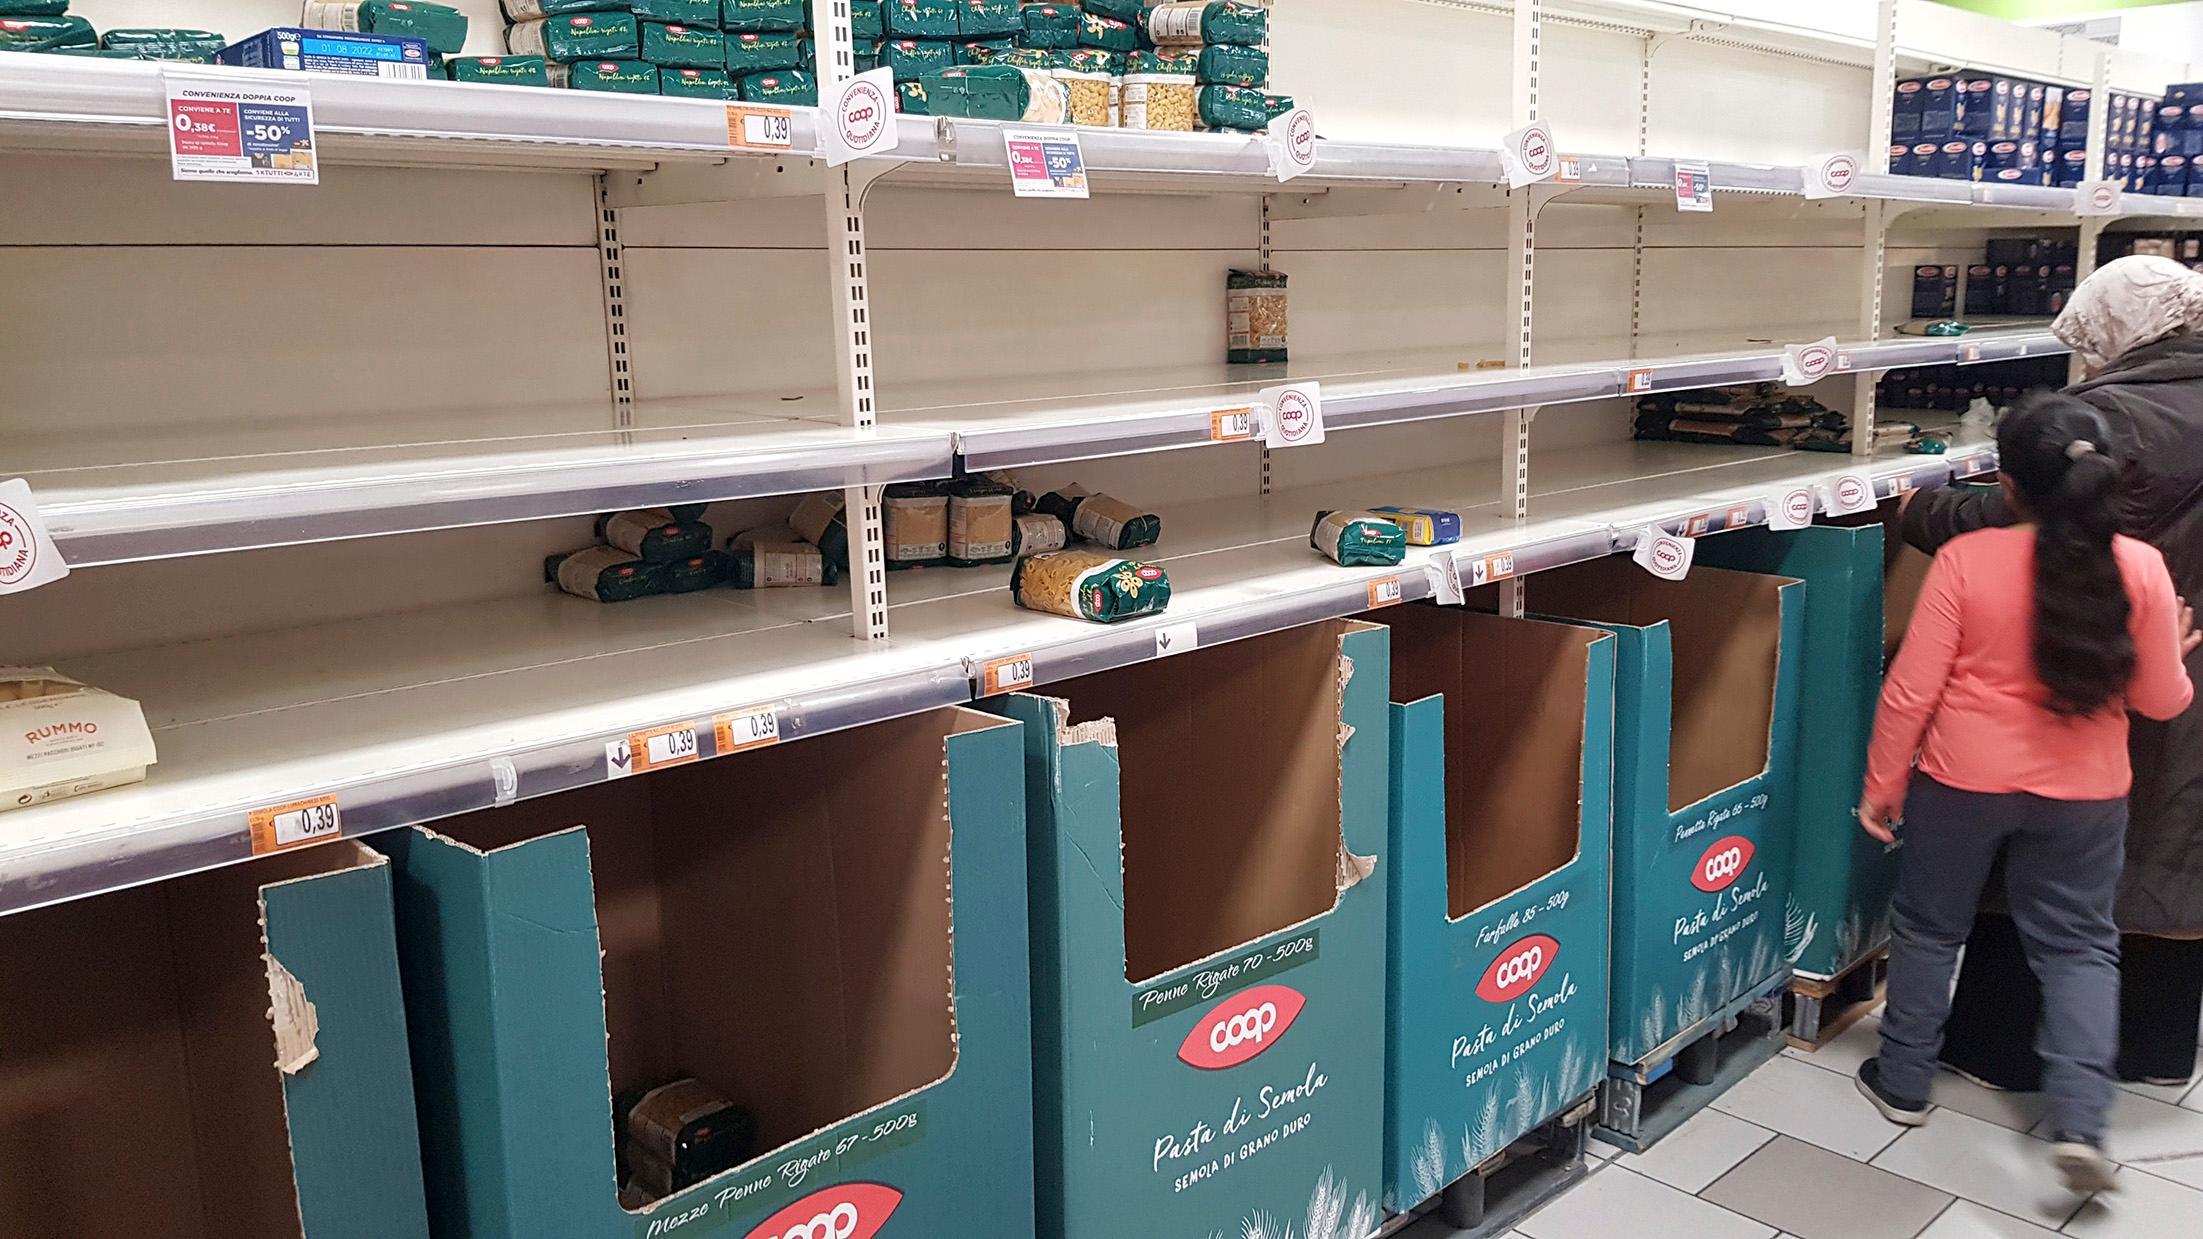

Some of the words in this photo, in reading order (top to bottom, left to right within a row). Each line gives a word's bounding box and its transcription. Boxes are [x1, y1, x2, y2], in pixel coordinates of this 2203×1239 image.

[321, 44, 331, 52] 01
[352, 47, 373, 55] 2022
[182, 90, 240, 99] CONVENIENZA
[243, 93, 272, 101] DOPPIA
[842, 86, 880, 113] CONVENIENZA
[175, 113, 216, 133] 0,38€
[849, 106, 874, 123] coop
[246, 124, 291, 142] -50%
[764, 116, 788, 142] 0,39
[845, 121, 881, 145] QUOTIDIANA
[1529, 145, 1545, 158] coop
[1278, 393, 1308, 411] CONVENIENZA
[1233, 413, 1248, 433] 0,39
[1282, 410, 1303, 421] coop
[1280, 421, 1309, 439] QUOTIDIANA
[1656, 550, 1676, 562] coop
[1386, 580, 1400, 598] 0,39
[1012, 660, 1030, 681] 0,39
[25, 722, 97, 744] RUMMO
[751, 713, 775, 738] 0,39
[668, 729, 694, 756] 0,39
[302, 804, 334, 834] 0,39
[1707, 809, 1731, 830] Rigate
[1705, 847, 1741, 882] coop
[1475, 911, 1520, 948] Farfalle
[1522, 904, 1537, 923] 85
[1546, 889, 1570, 911] 500g
[1674, 908, 1709, 945] Pasta
[1712, 893, 1728, 922] di
[1731, 871, 1769, 912] Semola
[1683, 941, 1709, 962] SEMOLA
[1709, 935, 1719, 947] DI
[1718, 921, 1742, 942] GRANO
[1139, 983, 1188, 1011] Penne
[1192, 964, 1240, 999] Rigate
[1242, 954, 1264, 973] 70
[1272, 937, 1313, 962] 500g
[1497, 945, 1542, 989] coop
[1209, 1002, 1277, 1053] coop
[1451, 1023, 1498, 1069] Pasta
[1502, 1003, 1524, 1036] di
[1527, 972, 1578, 1023] Semola
[1465, 1059, 1499, 1088] SEMOLA
[1501, 1053, 1511, 1066] DI
[1513, 1033, 1543, 1060] GRANO
[1544, 1017, 1566, 1041] DURO
[1153, 1120, 1217, 1173] Pasta
[1223, 1097, 1251, 1135] di
[1258, 1062, 1329, 1119] Semola
[1174, 1160, 1220, 1193] SEMOLA
[1223, 1152, 1235, 1170] DI
[1239, 1129, 1279, 1161] GRANO
[1282, 1112, 1312, 1138] DURO
[646, 1203, 710, 1239] Mezze
[714, 1175, 773, 1209] Penne
[776, 1149, 832, 1188] Rigate
[834, 1134, 860, 1156] 67
[867, 1112, 918, 1142] 500g
